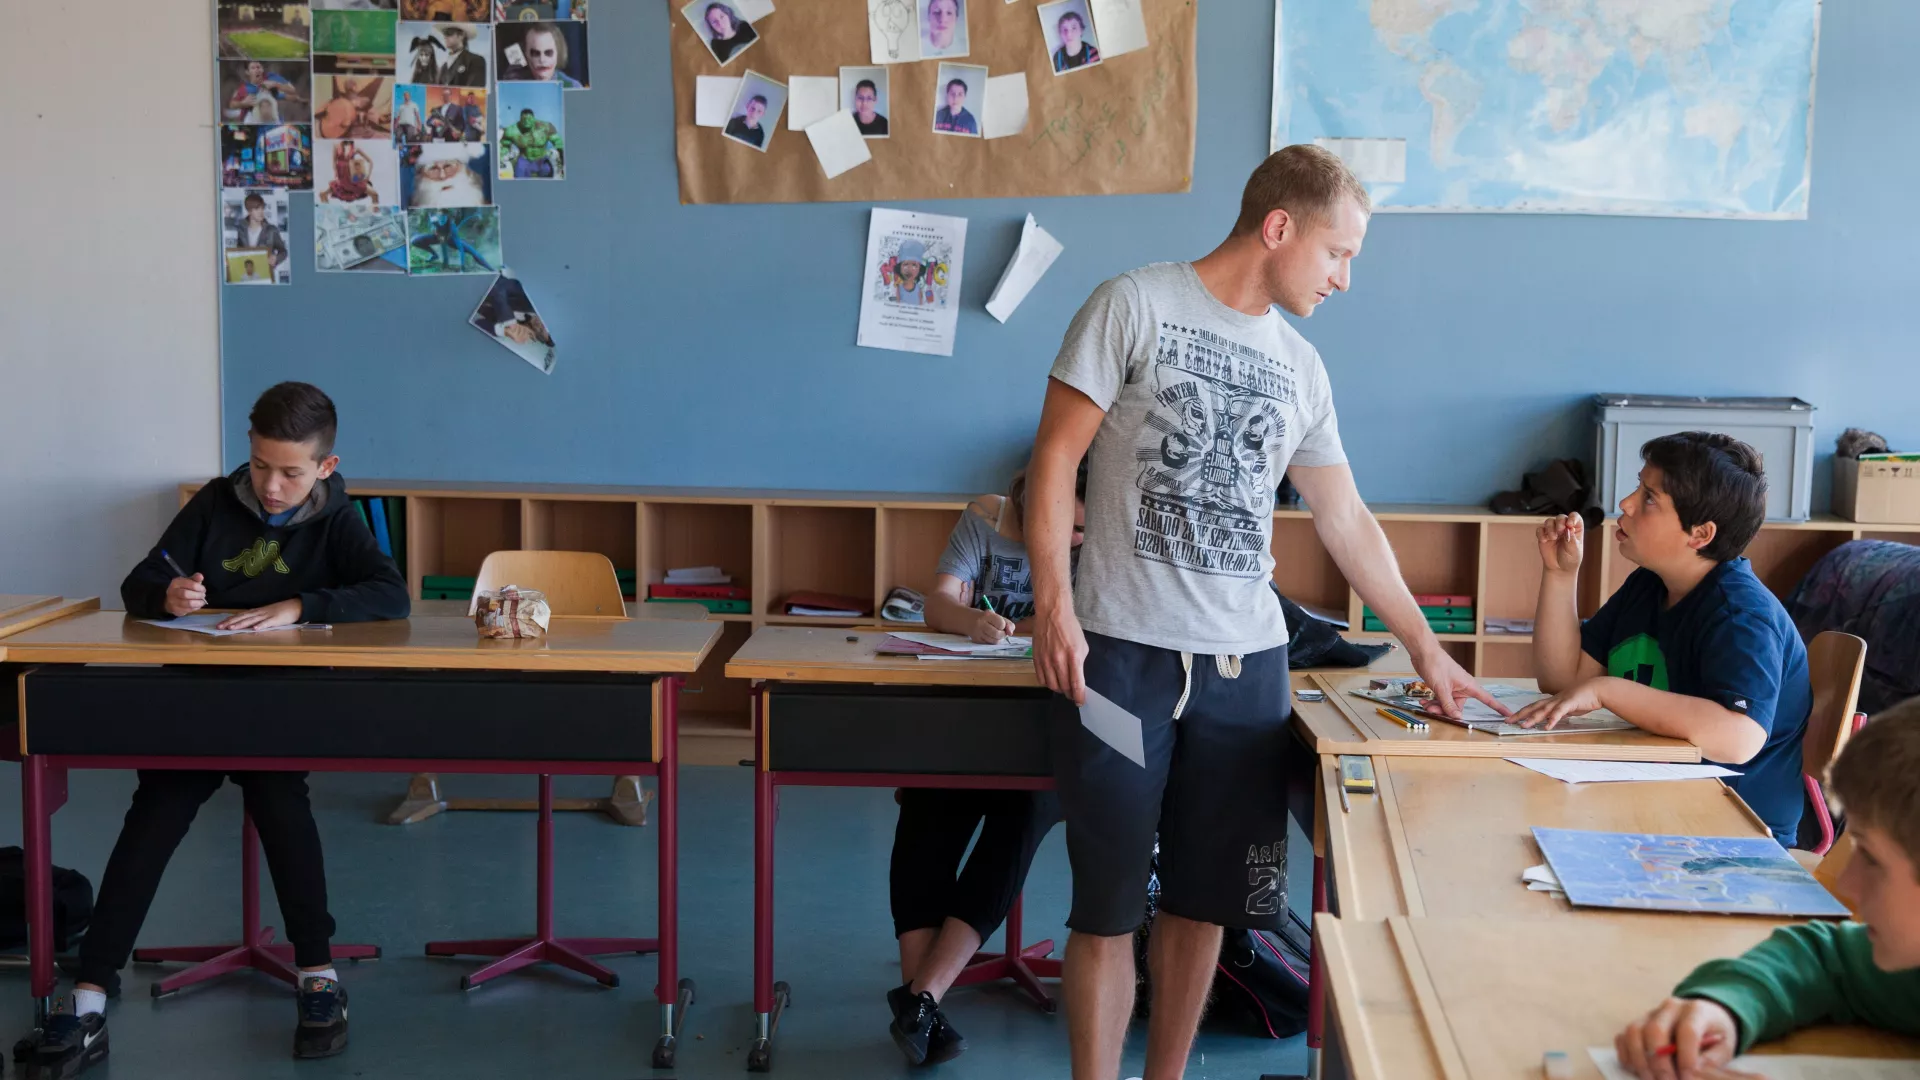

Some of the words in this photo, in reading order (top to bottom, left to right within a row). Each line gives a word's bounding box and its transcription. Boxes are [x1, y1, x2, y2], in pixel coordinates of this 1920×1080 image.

[1198, 328, 1218, 345] BAILAR
[1156, 335, 1178, 366] LA
[1155, 381, 1199, 408] PANTERA
[1208, 467, 1231, 485] LIBRE
[1134, 529, 1160, 554] 1928
[1181, 520, 1195, 542] 28
